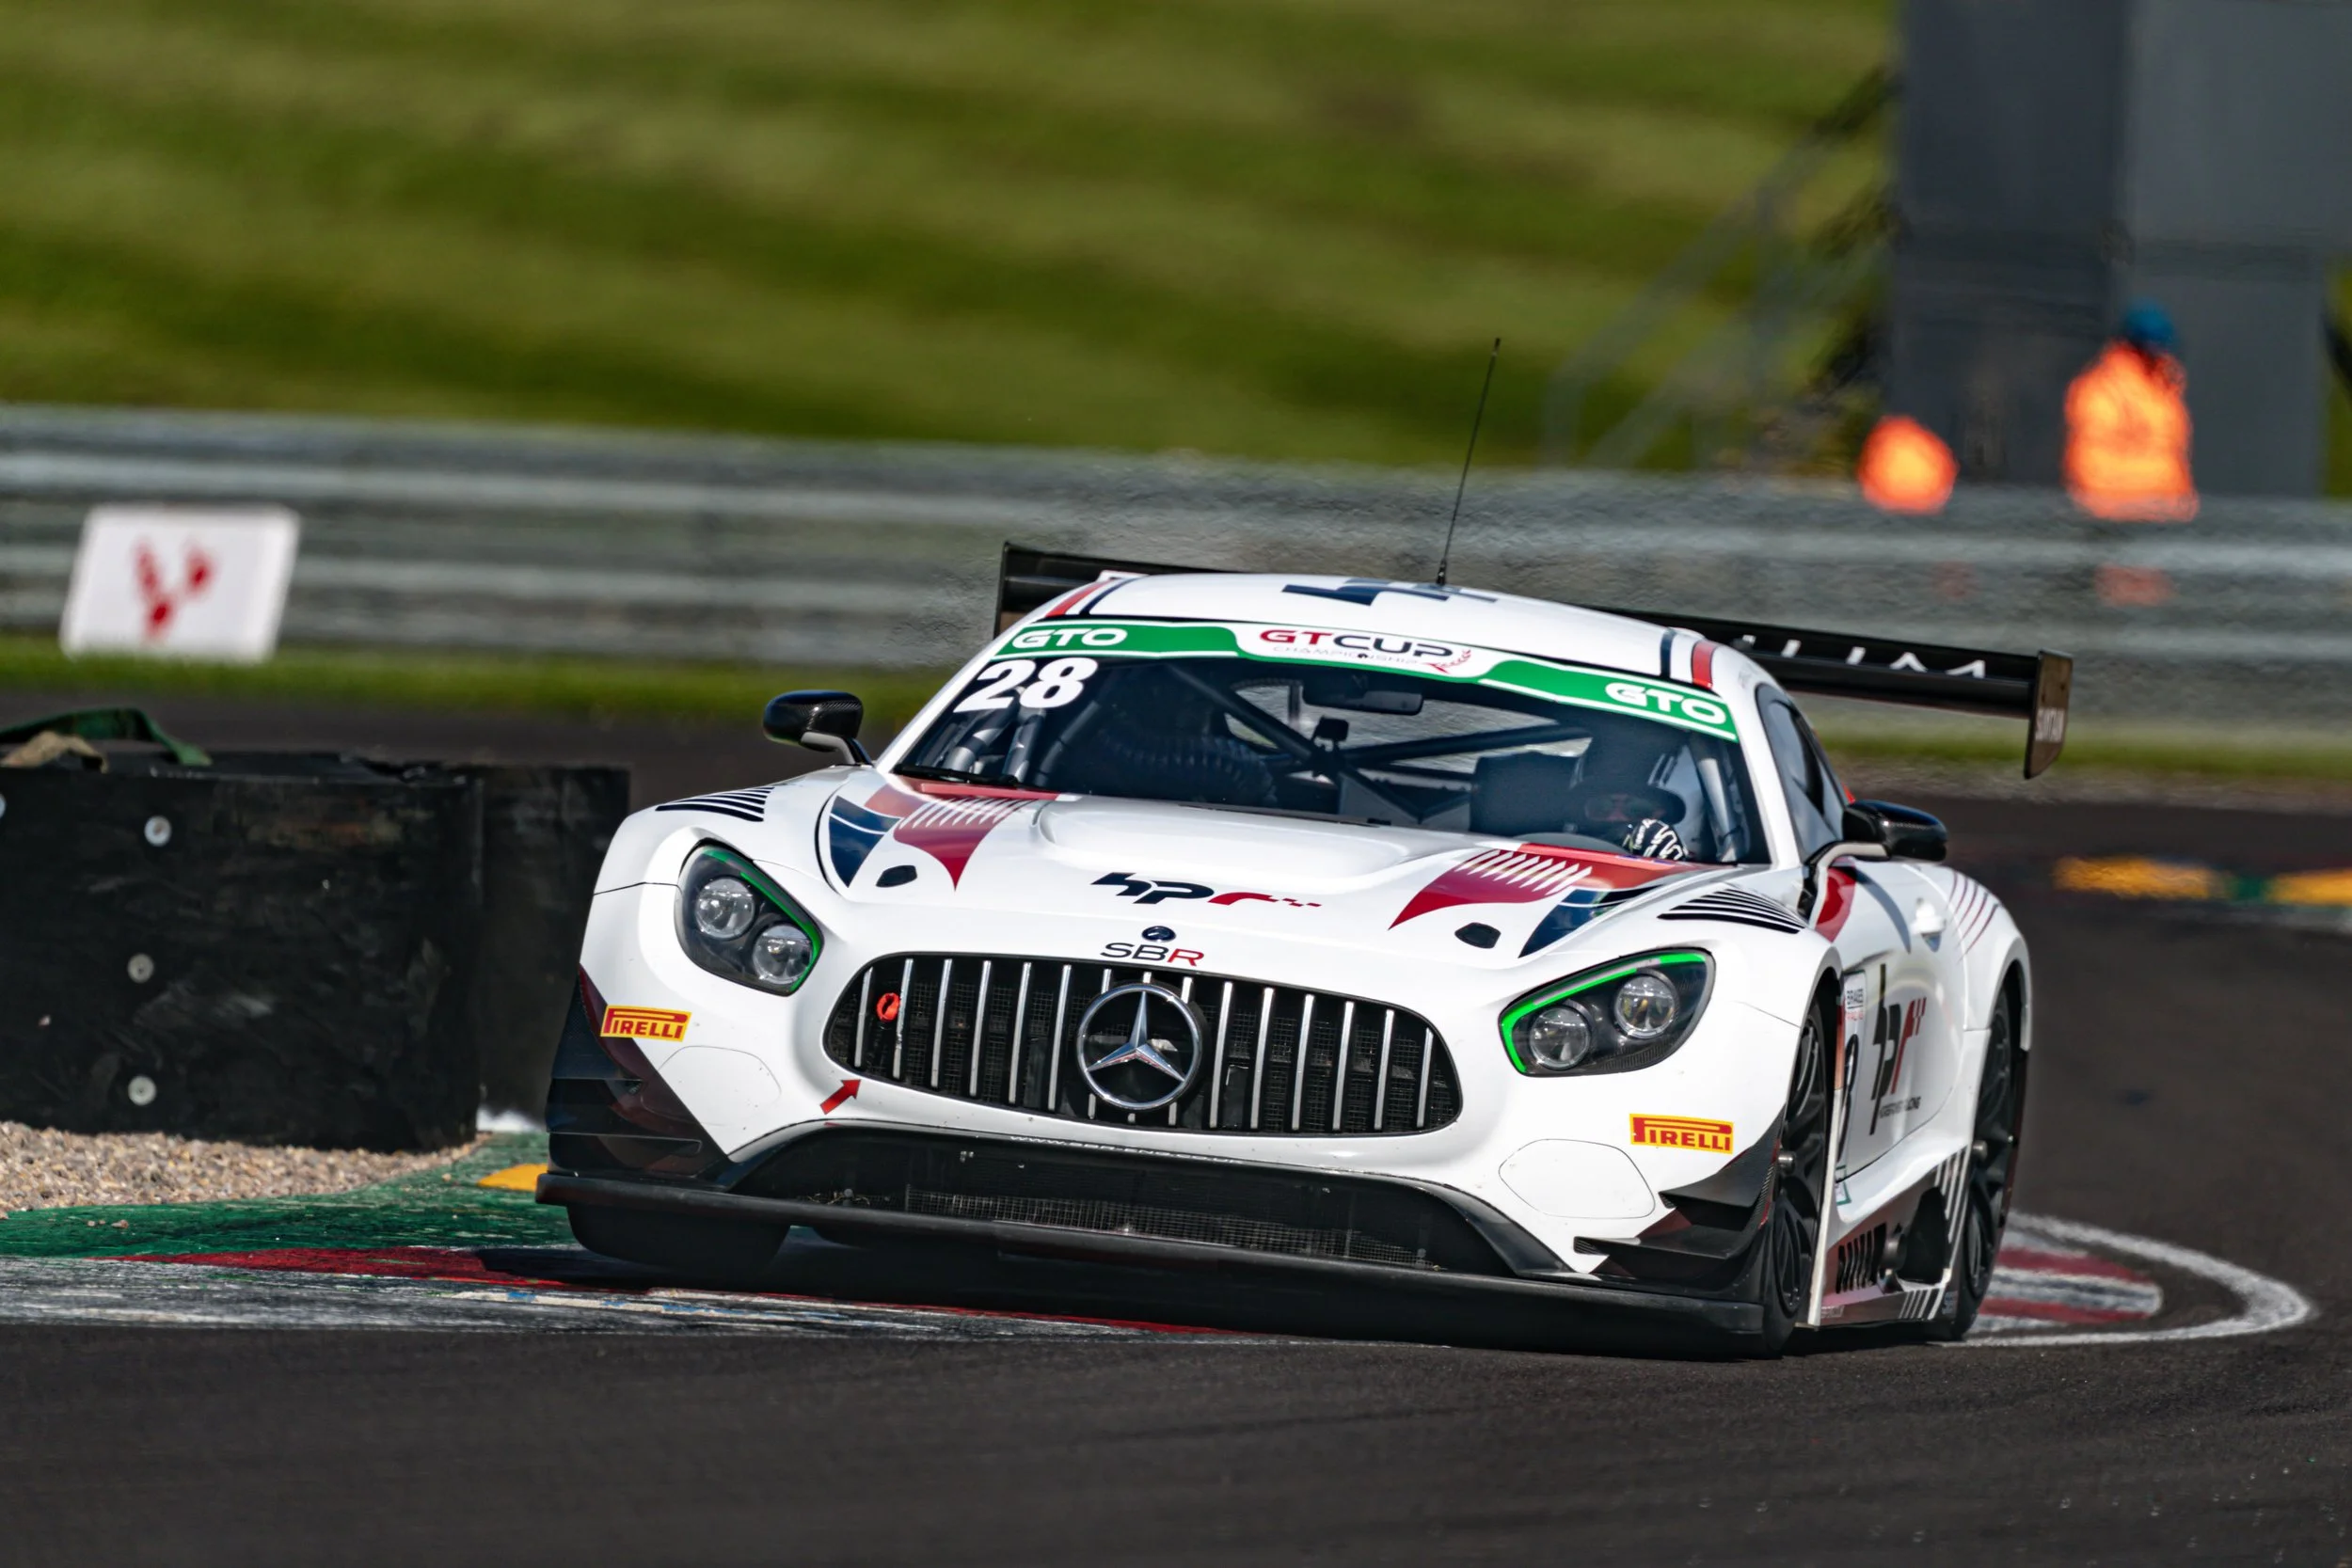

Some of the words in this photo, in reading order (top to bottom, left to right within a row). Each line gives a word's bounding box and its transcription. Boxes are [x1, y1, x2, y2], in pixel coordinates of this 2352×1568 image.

[1011, 627, 1128, 649] GTO
[952, 657, 1099, 713] 28
[1605, 682, 1727, 725] GTO
[1100, 942, 1205, 967] SBR
[603, 1007, 689, 1039] PIRELLI
[1632, 1117, 1732, 1151] PIRELLI
